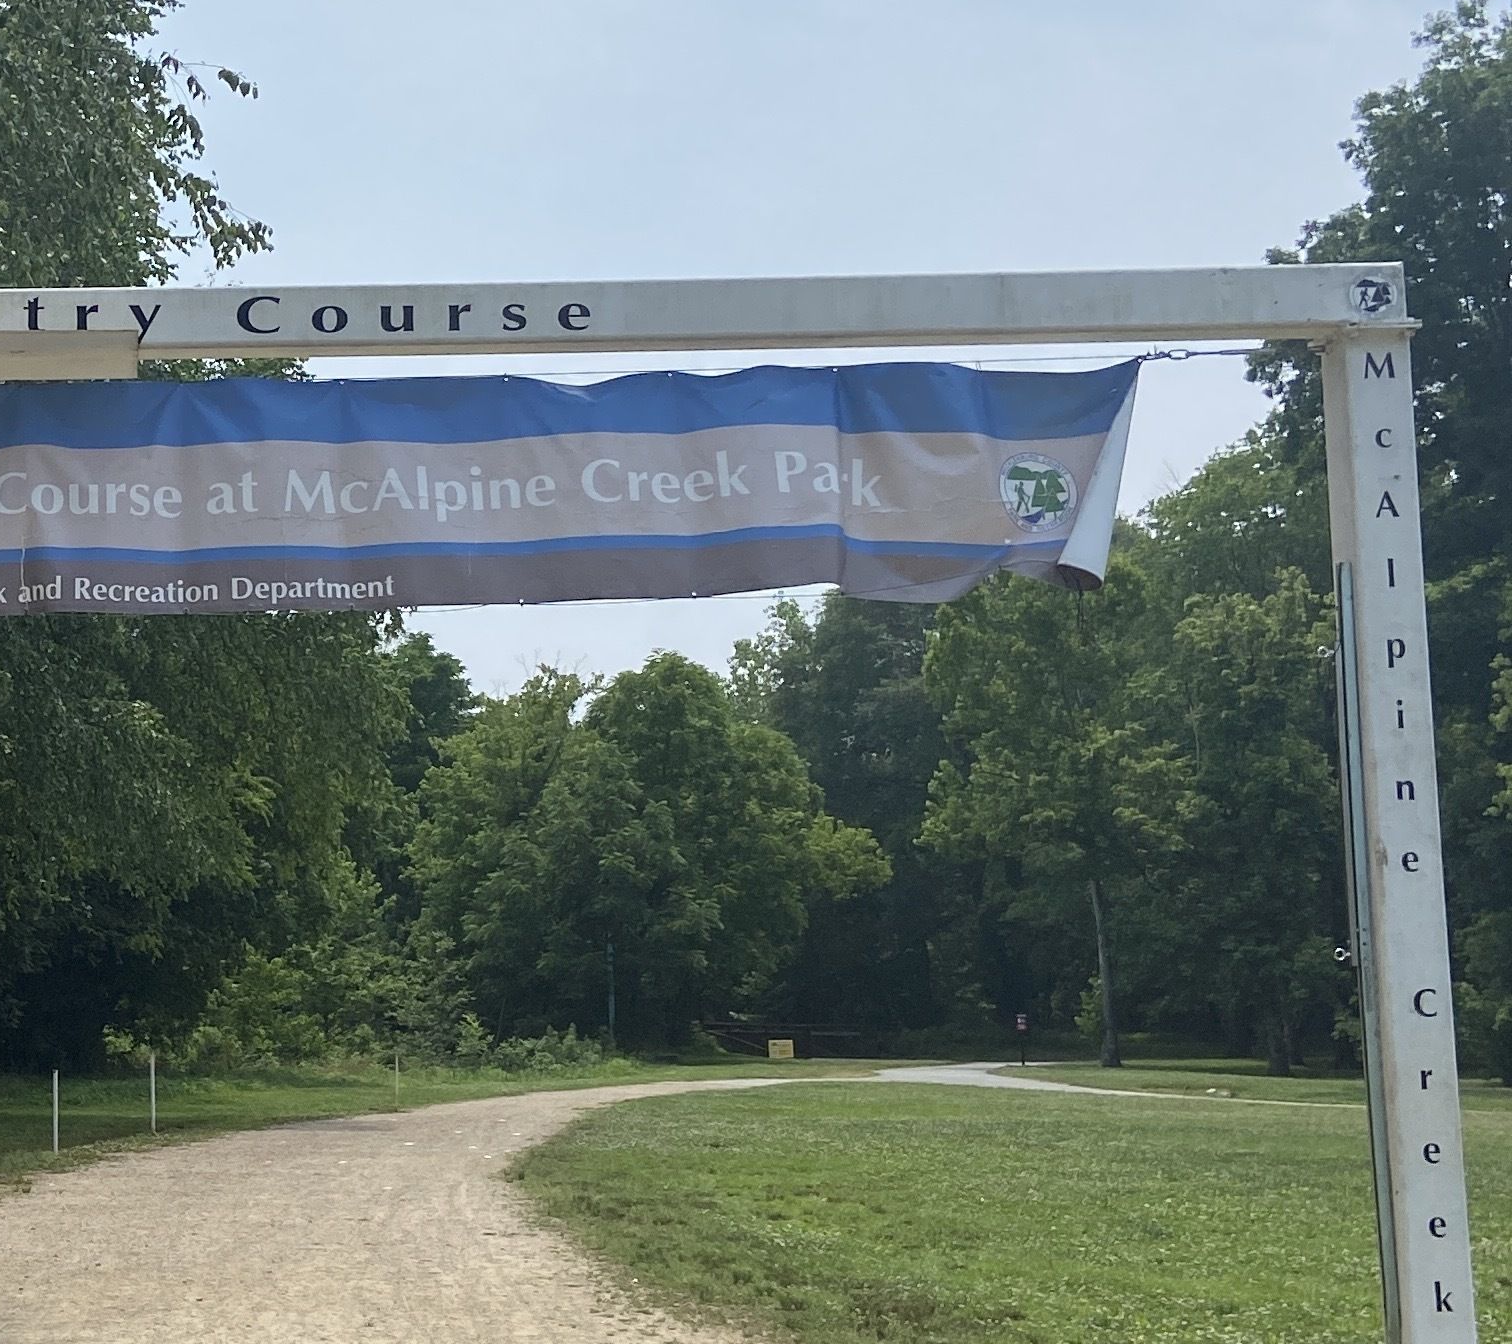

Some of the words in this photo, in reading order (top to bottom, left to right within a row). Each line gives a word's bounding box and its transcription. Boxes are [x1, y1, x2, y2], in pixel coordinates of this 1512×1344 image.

[236, 295, 591, 335] Course
[206, 471, 258, 515] at
[284, 465, 557, 523] McAlpine
[581, 449, 751, 505] Creek
[773, 450, 883, 507] Pak
[17, 575, 62, 605] and
[74, 576, 219, 604] Recreation
[230, 573, 395, 605] Department
[1363, 351, 1420, 874] McAlpine
[1412, 987, 1455, 1314] Creek
